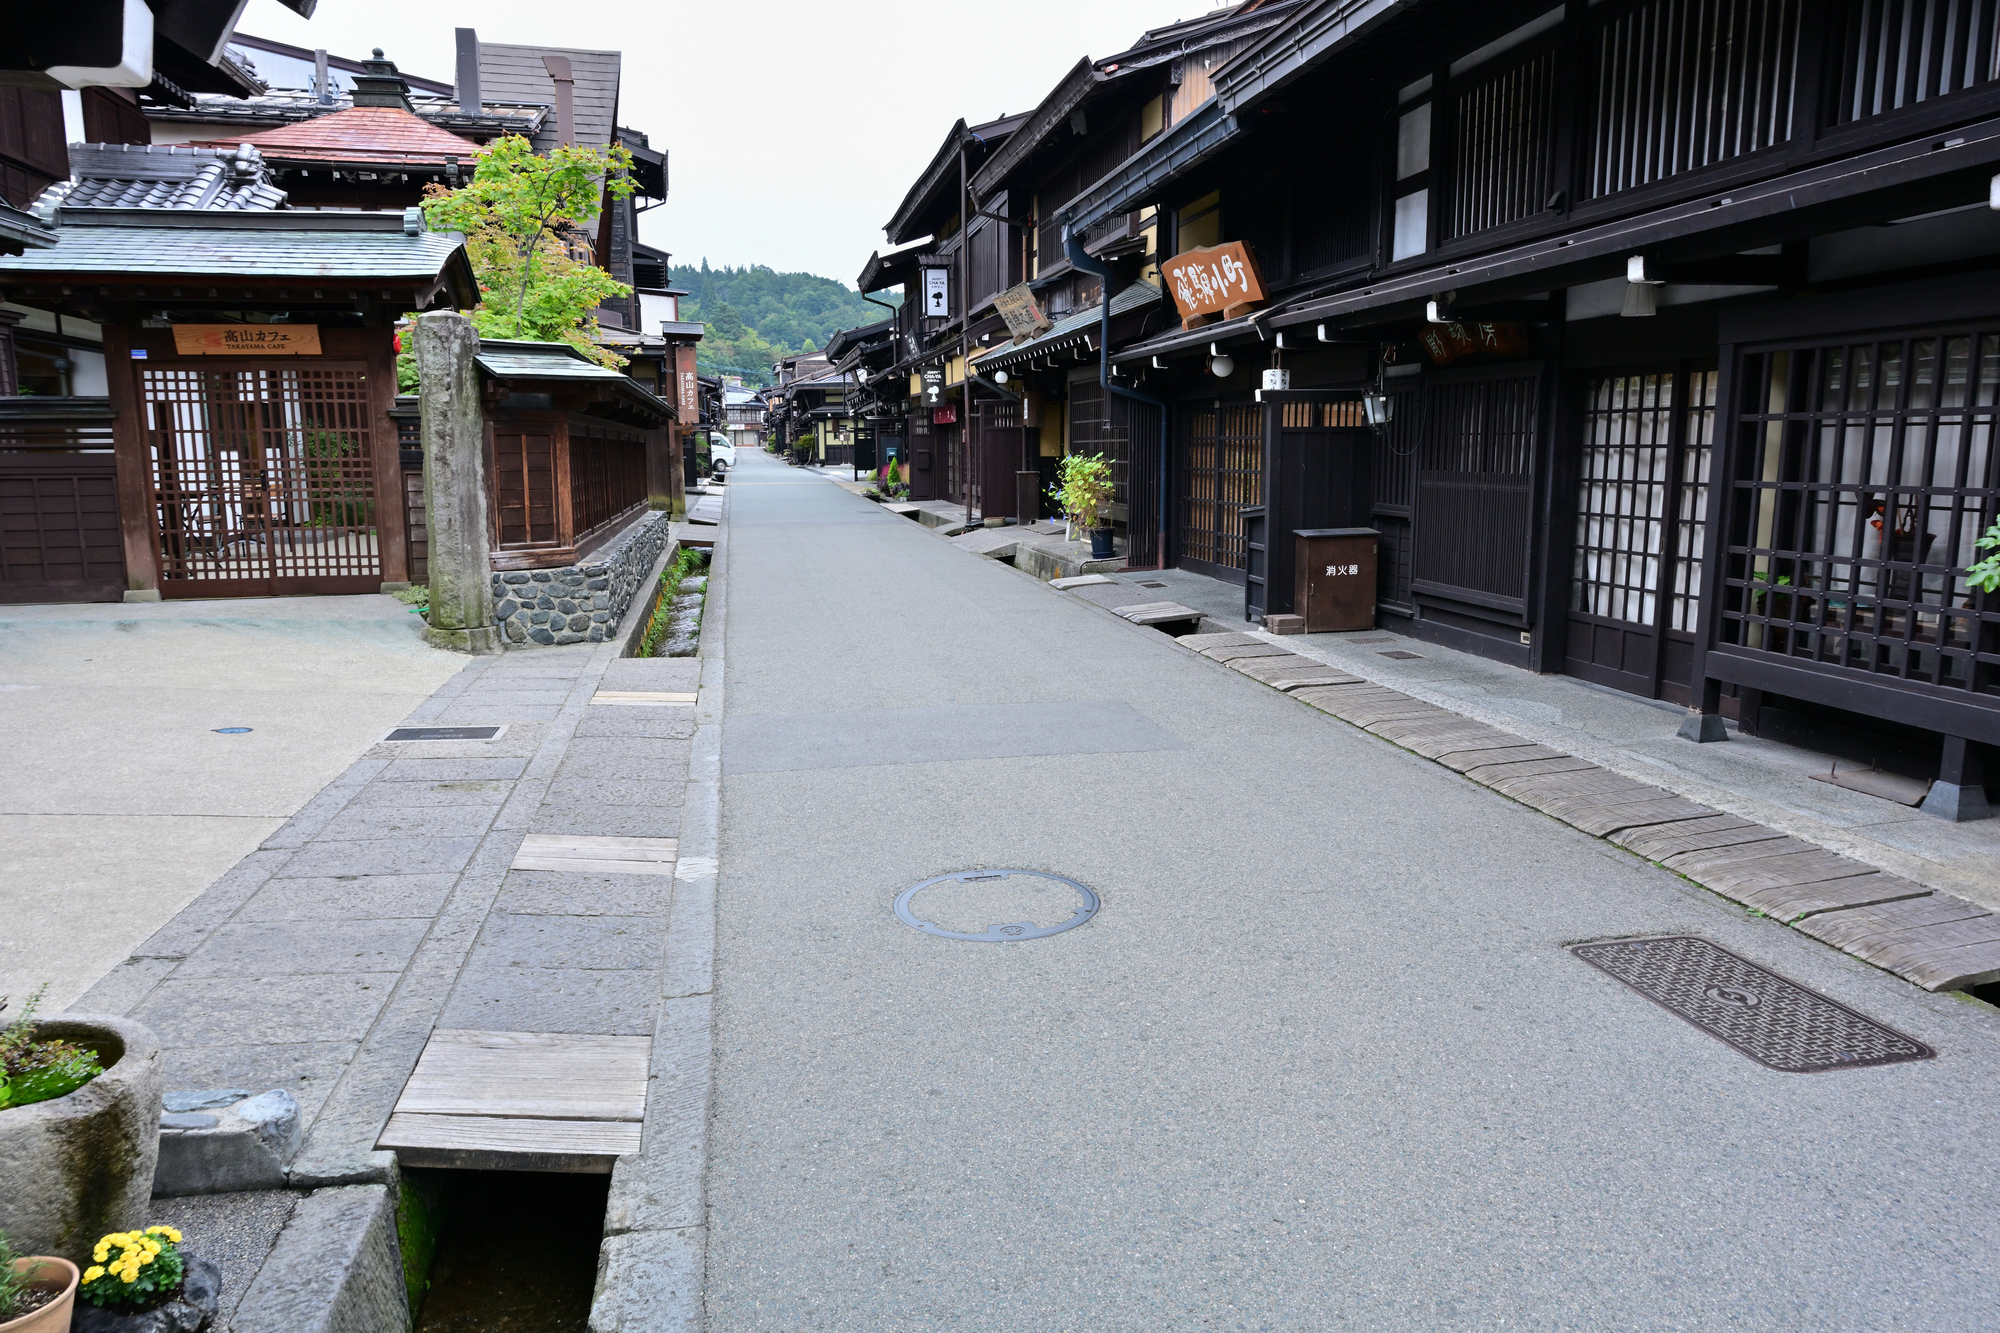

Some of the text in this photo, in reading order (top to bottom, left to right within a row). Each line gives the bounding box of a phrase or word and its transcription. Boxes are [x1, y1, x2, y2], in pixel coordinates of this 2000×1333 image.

[224, 329, 291, 343] 高山カフェ
[685, 372, 695, 410] 高山カフェ
[1325, 564, 1358, 577] 消火器
